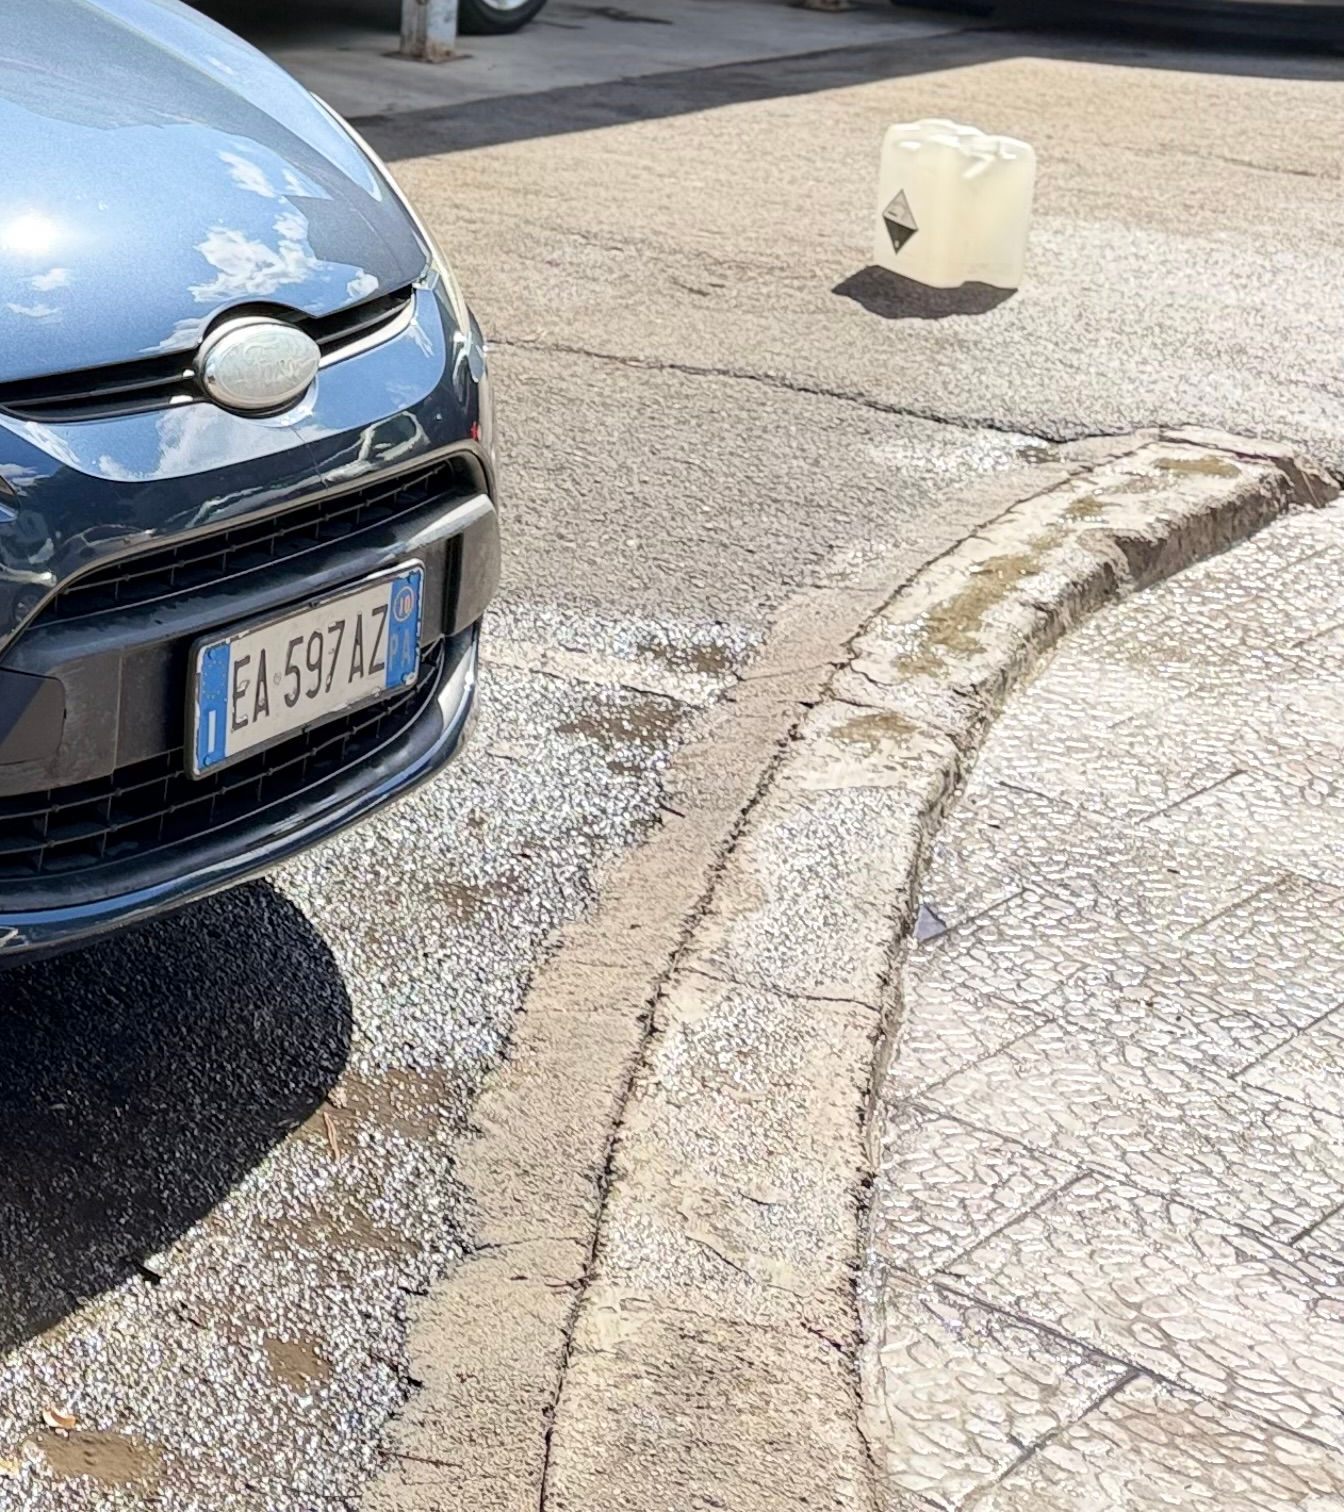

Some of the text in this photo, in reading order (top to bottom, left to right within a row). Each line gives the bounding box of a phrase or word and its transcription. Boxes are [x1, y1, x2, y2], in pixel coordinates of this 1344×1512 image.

[231, 603, 389, 733] EA 597AZ
[388, 628, 411, 672] PA
